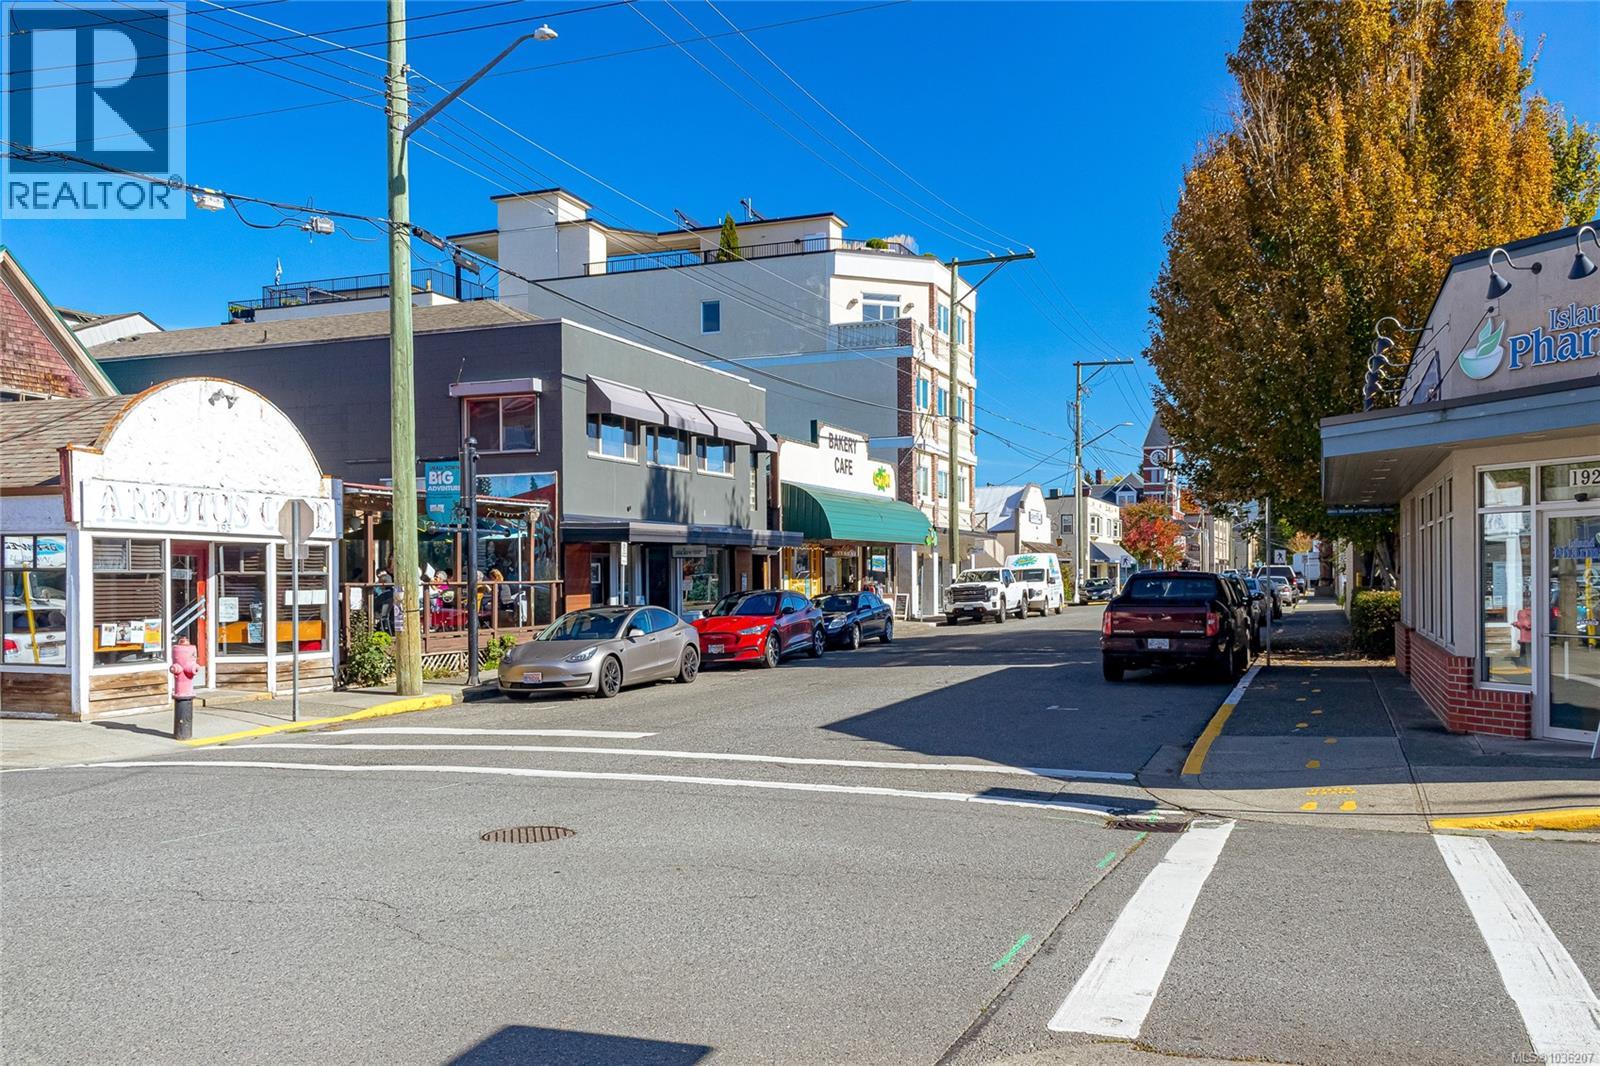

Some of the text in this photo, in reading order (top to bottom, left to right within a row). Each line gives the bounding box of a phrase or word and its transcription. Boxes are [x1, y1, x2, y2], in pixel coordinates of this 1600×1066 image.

[1507, 326, 1600, 370] Phar
[828, 432, 858, 455] BAKERY
[834, 456, 854, 476] CAFE
[96, 484, 334, 534] ARBUTUS CE
